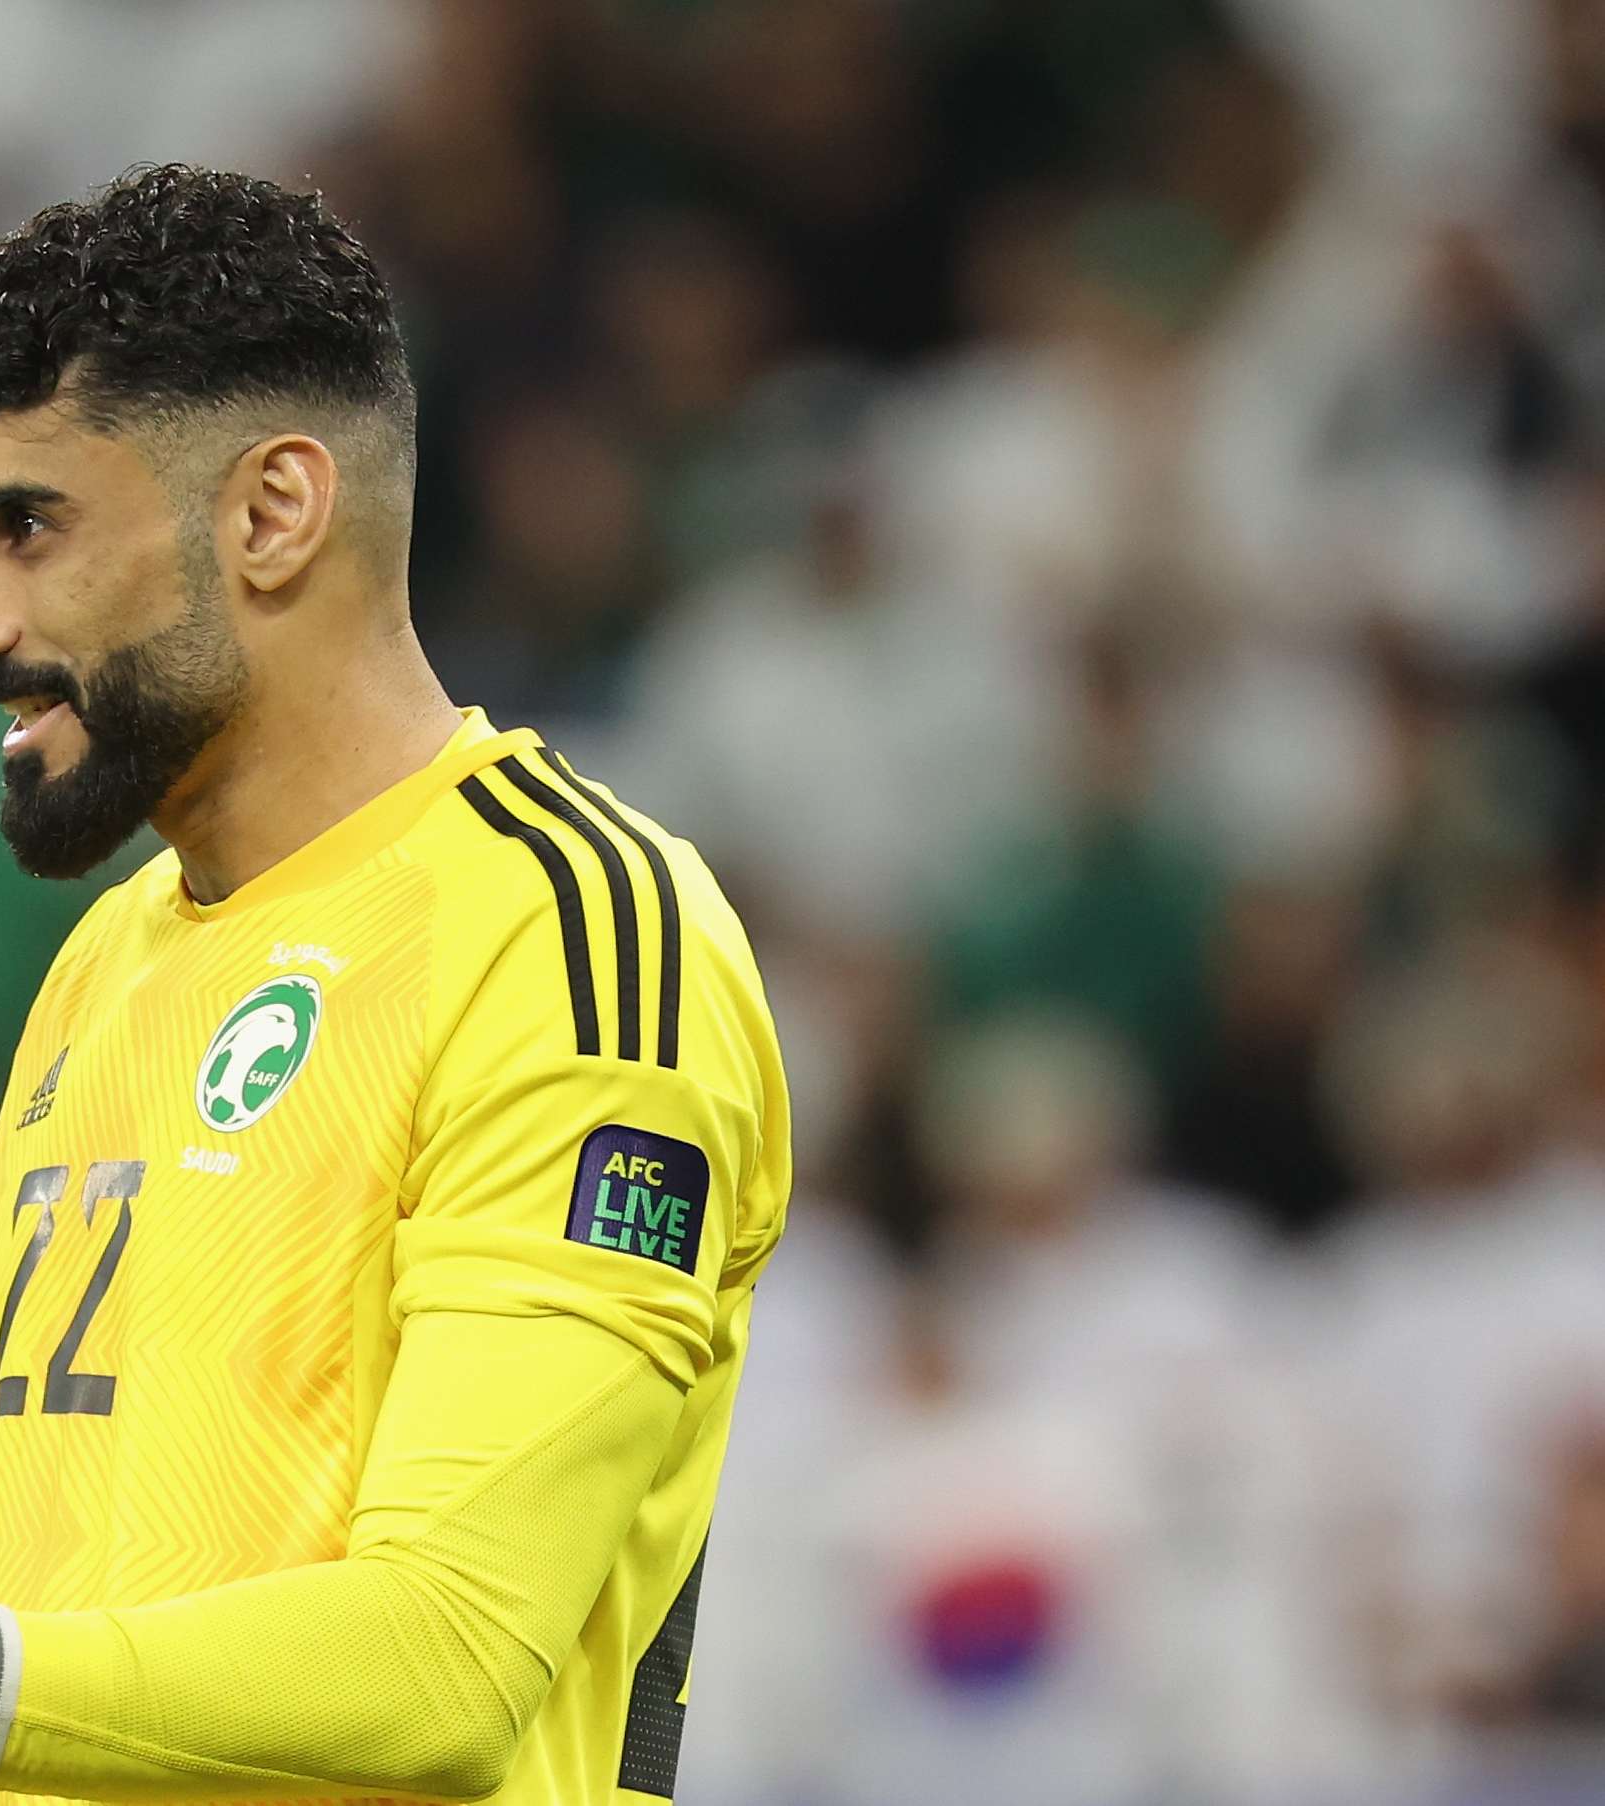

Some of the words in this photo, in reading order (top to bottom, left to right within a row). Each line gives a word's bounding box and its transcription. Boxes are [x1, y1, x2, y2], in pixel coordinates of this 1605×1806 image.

[247, 1070, 280, 1087] SAFF
[178, 1145, 241, 1176] SAUDI
[603, 1152, 664, 1186] AFC
[594, 1179, 690, 1239] LIVE
